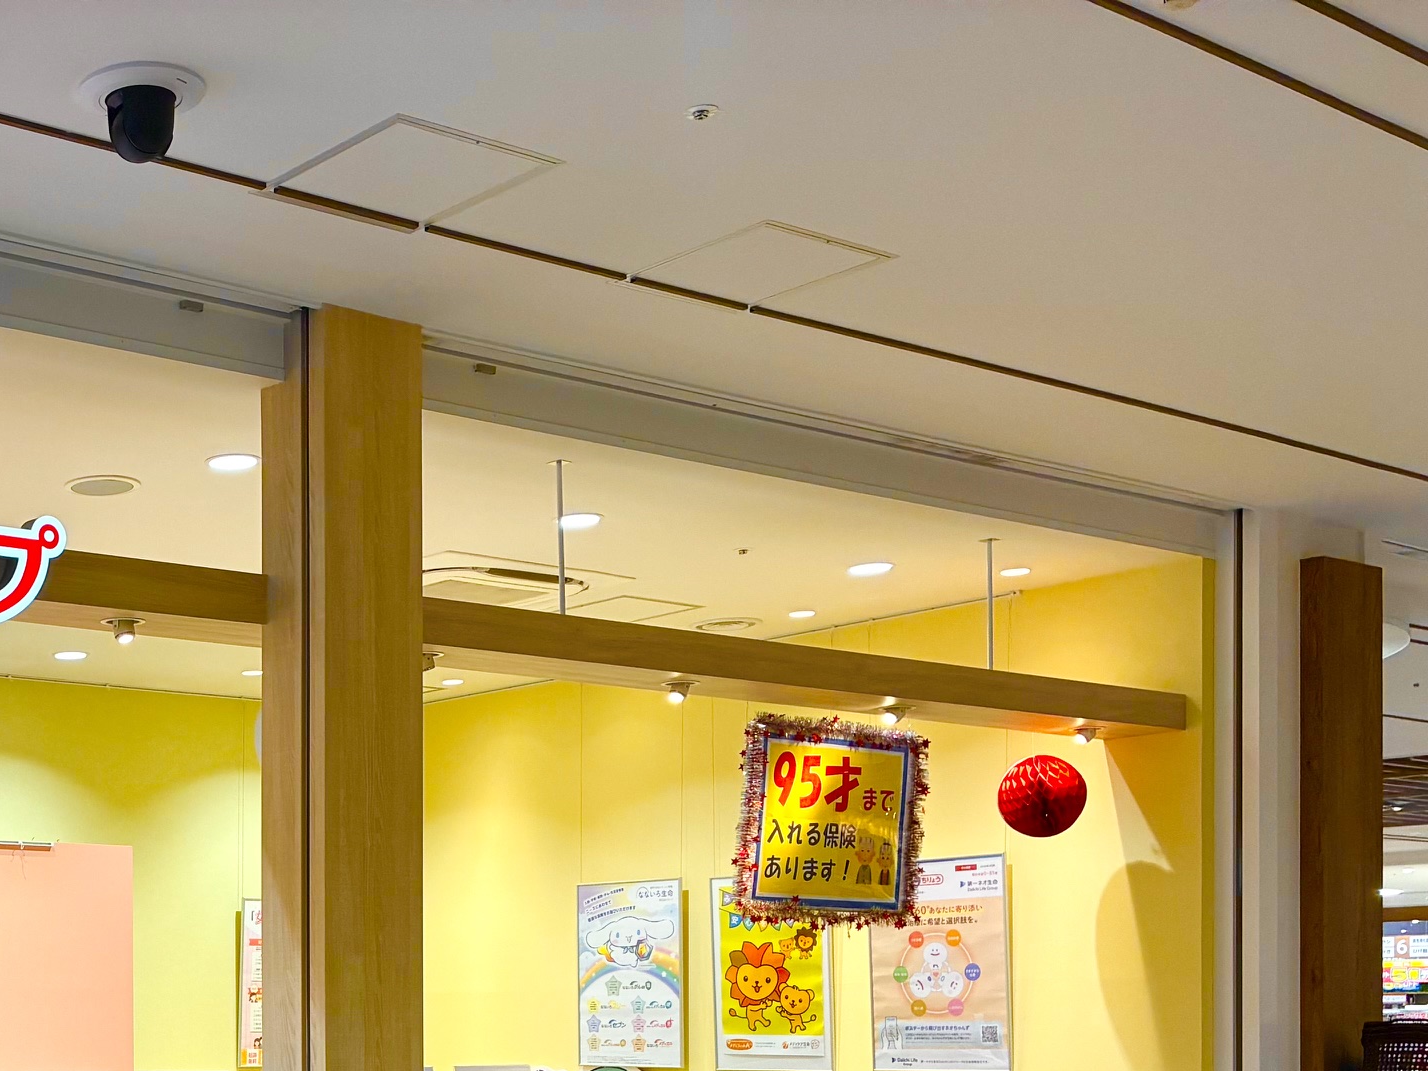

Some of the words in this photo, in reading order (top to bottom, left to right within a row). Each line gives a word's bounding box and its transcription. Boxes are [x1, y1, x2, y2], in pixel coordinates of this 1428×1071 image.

[772, 750, 895, 813] 95才まで
[766, 818, 858, 849] 入れる保険
[638, 889, 674, 899] なないろ生命
[1395, 938, 1408, 955] 6
